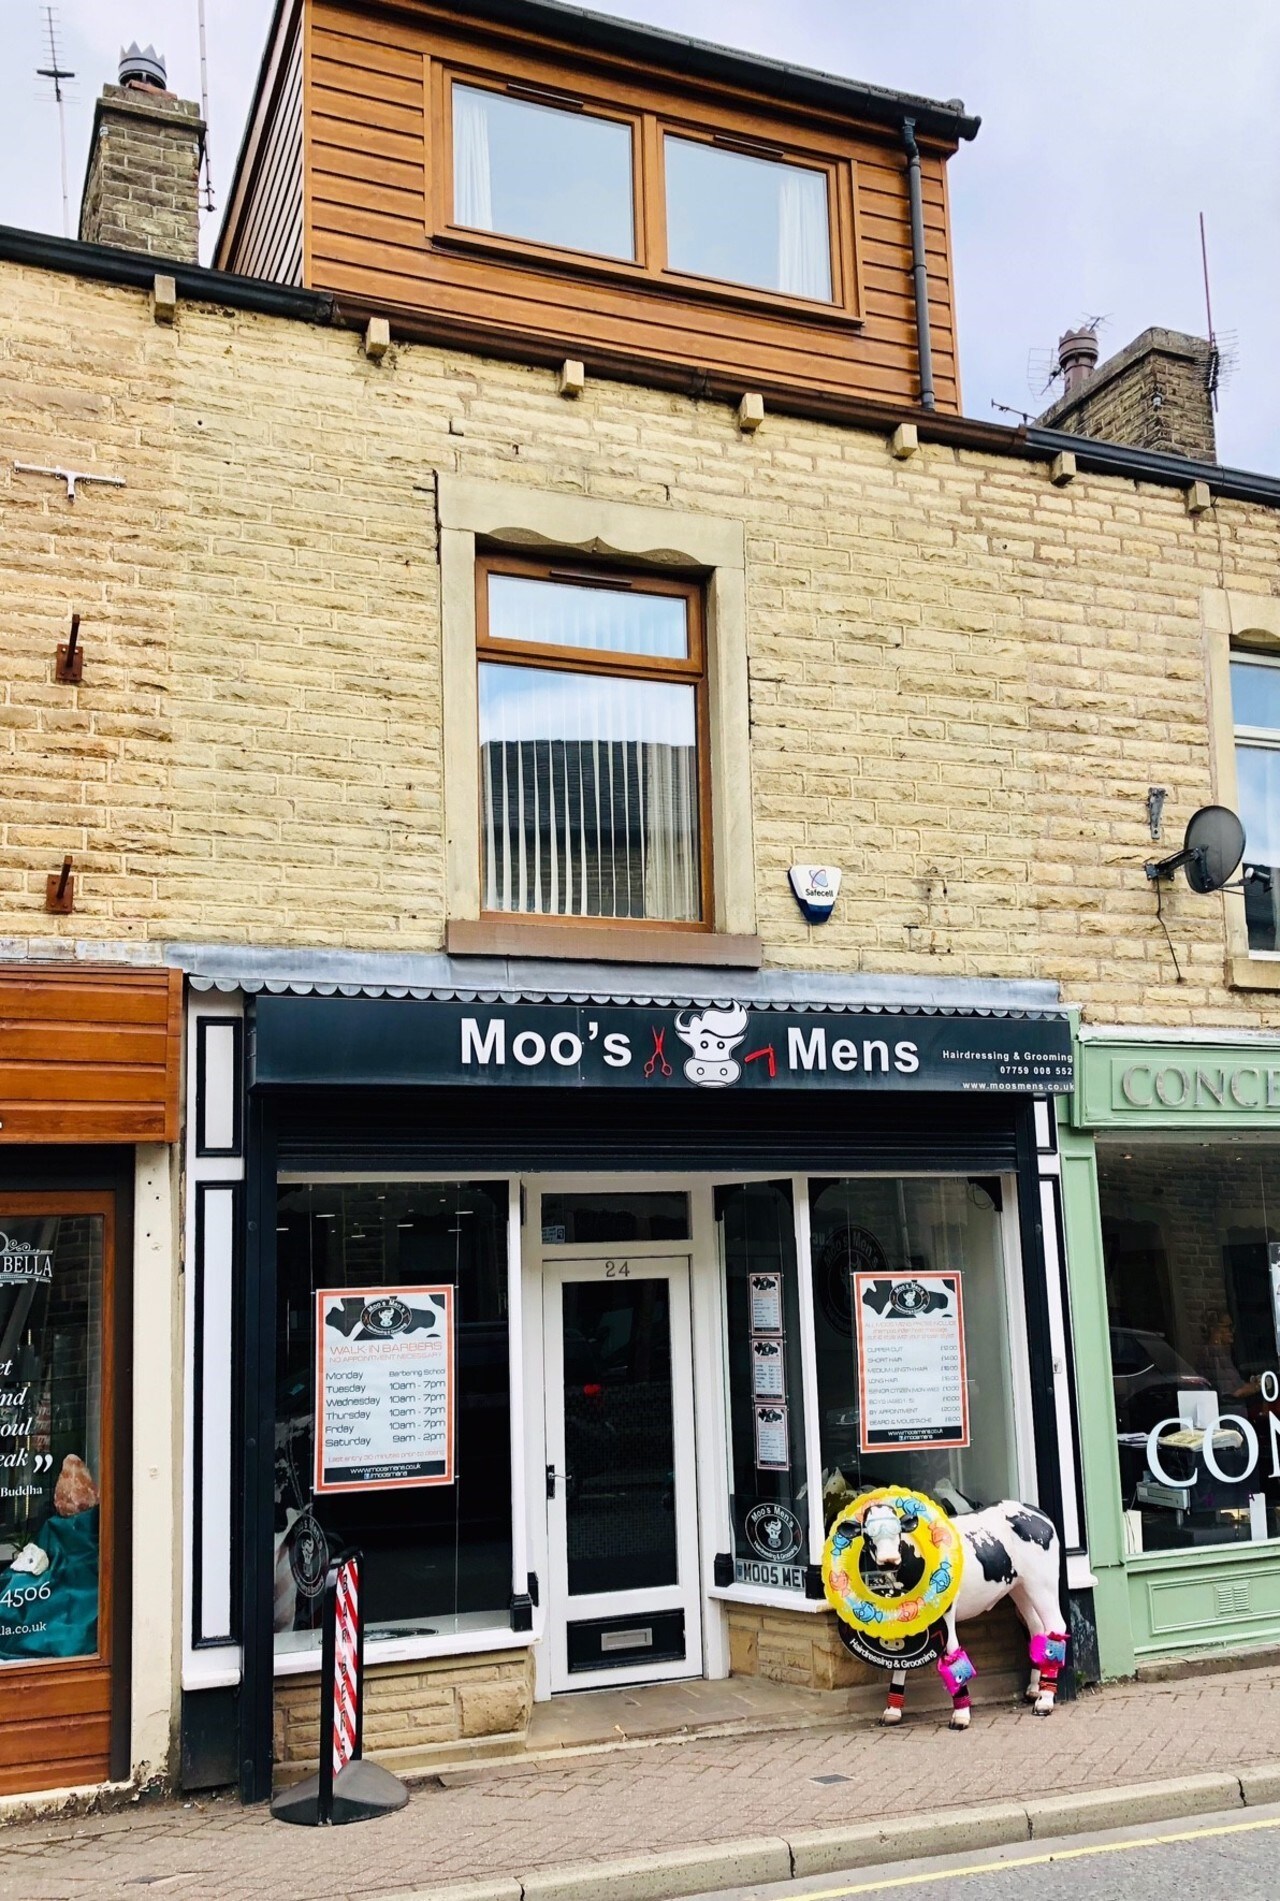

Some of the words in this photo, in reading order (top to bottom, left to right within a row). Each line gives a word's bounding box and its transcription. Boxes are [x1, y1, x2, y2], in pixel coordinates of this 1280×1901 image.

[805, 888, 834, 897] Safecell
[461, 1017, 632, 1067] Moo's
[787, 1027, 920, 1073] Mens
[942, 1050, 1009, 1061] Hairdressing
[1013, 1052, 1020, 1060] &
[1023, 1052, 1073, 1063] Grooming
[1000, 1066, 1029, 1074] 07759
[1033, 1067, 1051, 1075] 008
[1055, 1067, 1073, 1075] 552
[962, 1082, 1075, 1091] www.moosmens.co.uk
[3, 1256, 53, 1277] BELLA
[605, 1261, 630, 1277] 24
[330, 1345, 379, 1355] WALK-IN
[382, 1341, 442, 1352] BARBERS
[325, 1371, 363, 1381] Monday
[326, 1384, 366, 1393] Tuesday
[389, 1382, 415, 1390] 10am
[423, 1380, 445, 1389] 7pm
[326, 1397, 380, 1407] Wednesday
[389, 1395, 415, 1403] 10am
[423, 1393, 445, 1402] 7pm
[326, 1410, 371, 1420] Thursday
[389, 1408, 415, 1417] 10am
[423, 1407, 445, 1415] 7pm
[325, 1425, 354, 1434] Friday
[389, 1421, 415, 1430] 10am
[423, 1420, 445, 1429] 7pm
[325, 1437, 371, 1447] Saturday
[423, 1433, 445, 1442] 2pm
[0, 1485, 43, 1497] Buddha
[0, 1581, 51, 1608] 4506
[849, 1638, 893, 1669] Hairdressing
[894, 1660, 900, 1668] &
[901, 1649, 937, 1668] Grooming
